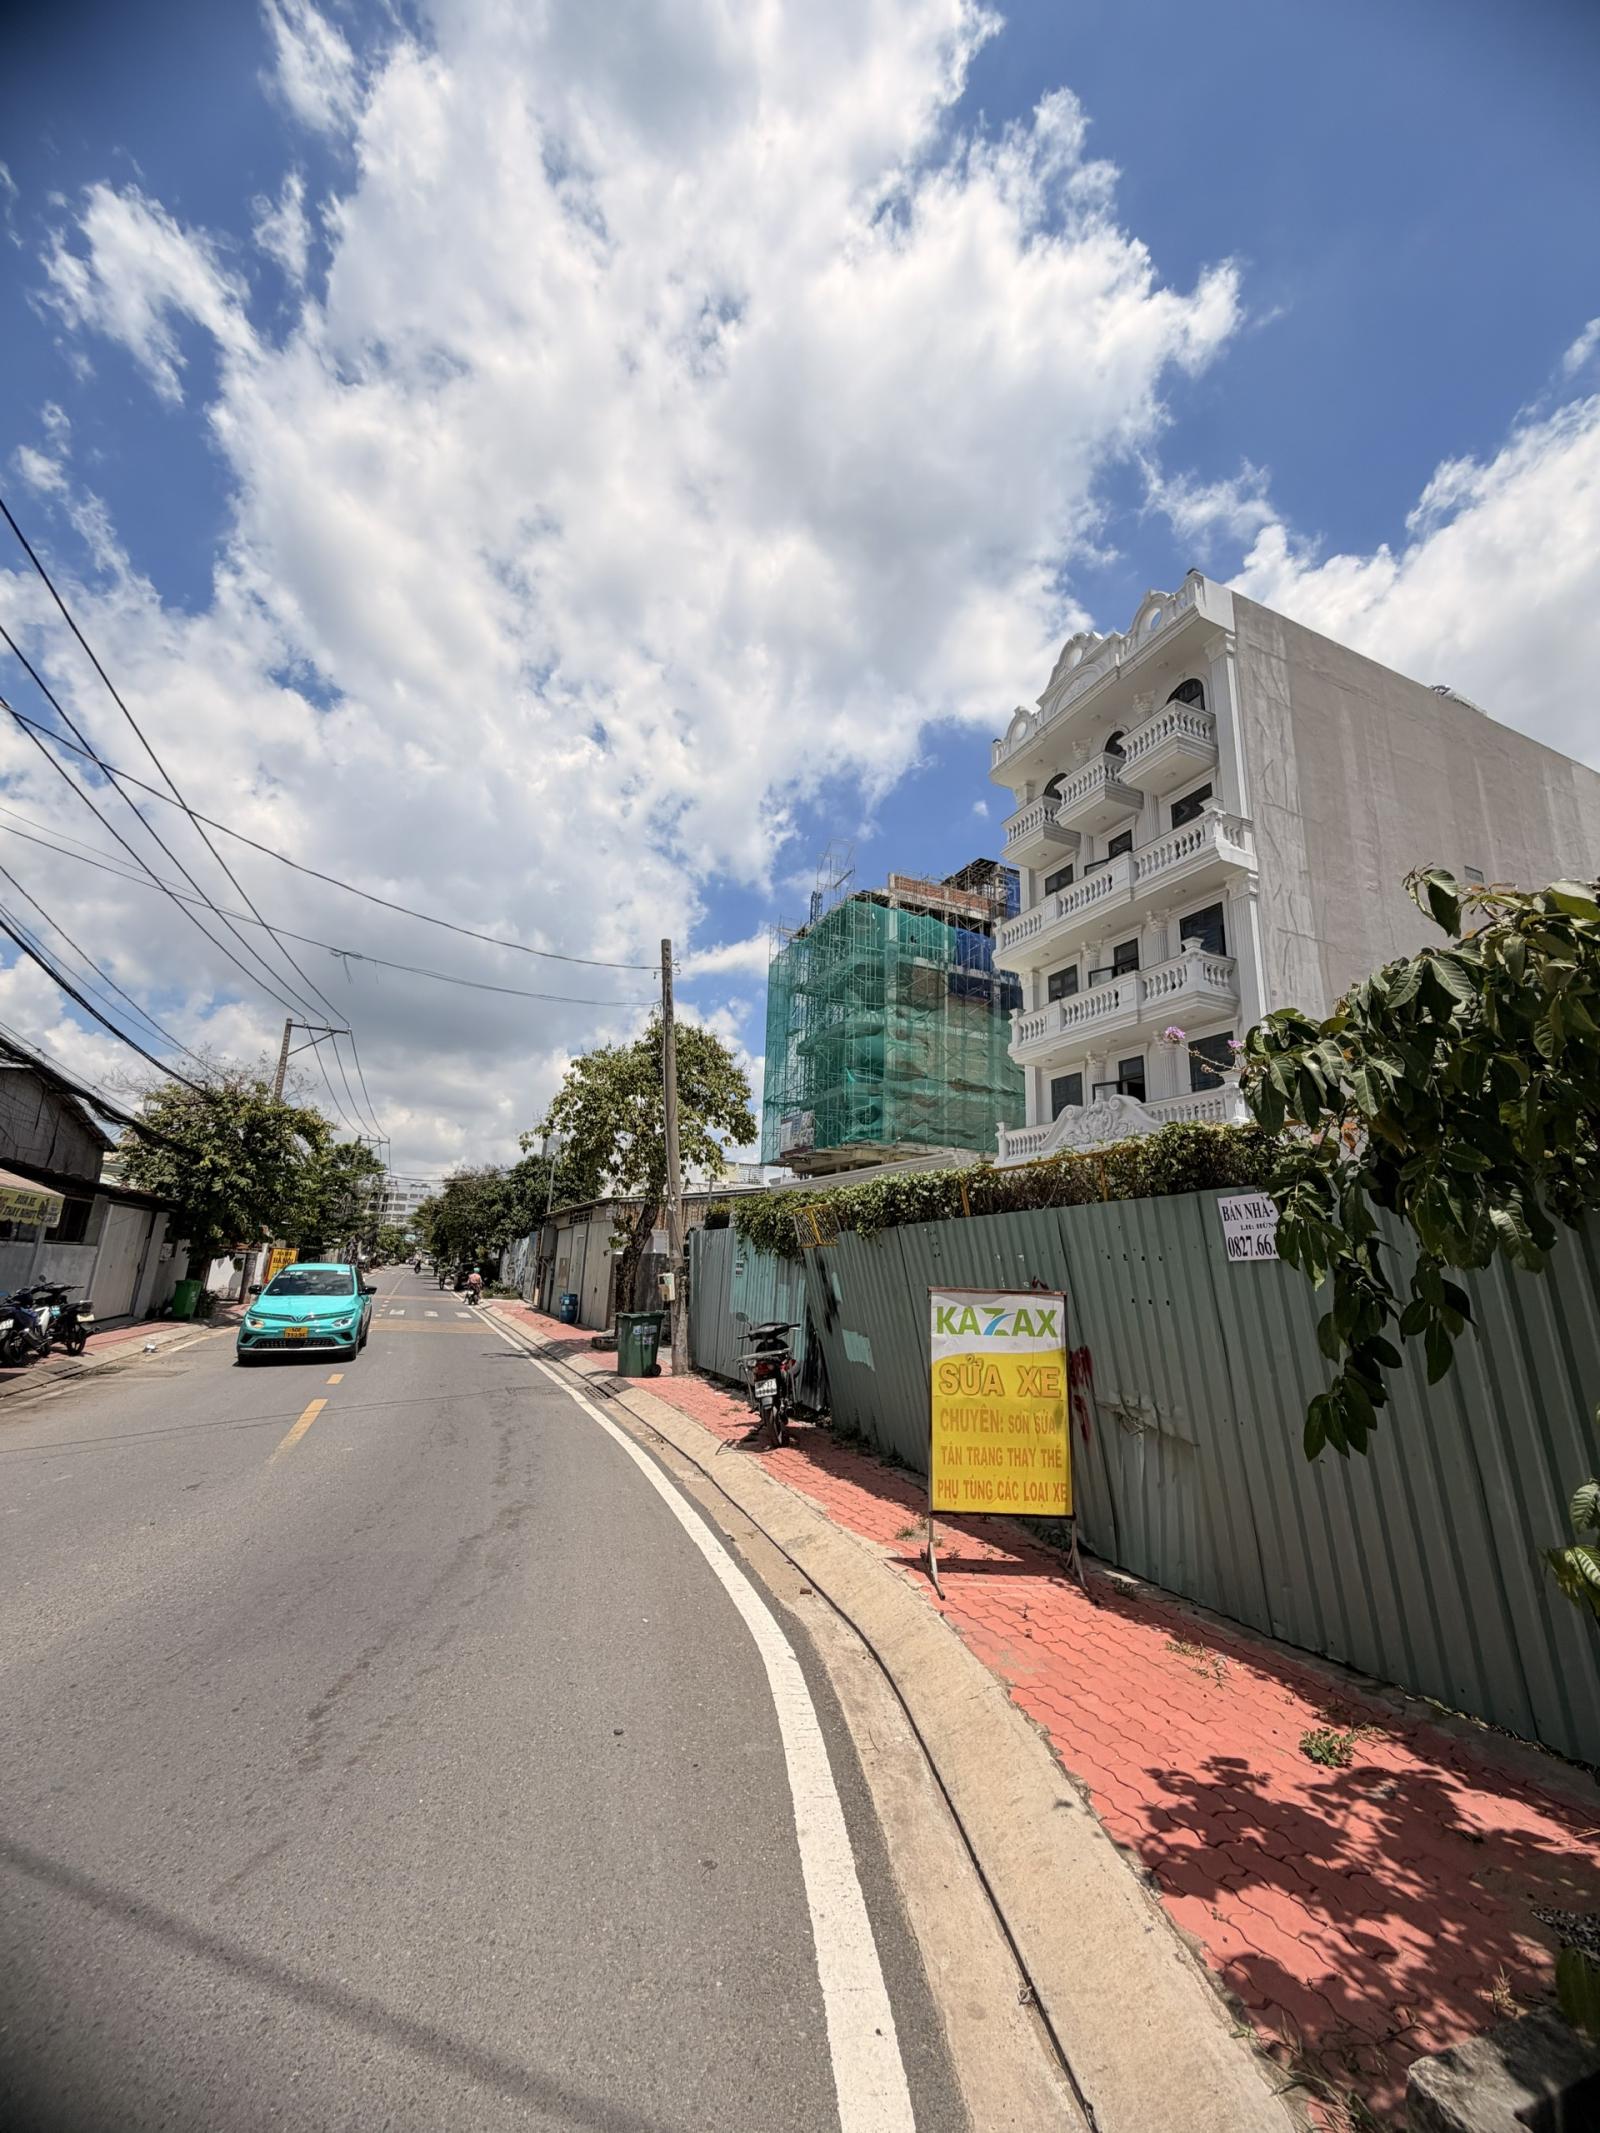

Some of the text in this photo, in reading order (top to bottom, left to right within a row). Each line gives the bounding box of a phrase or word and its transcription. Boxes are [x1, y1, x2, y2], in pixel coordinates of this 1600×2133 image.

[1222, 1200, 1243, 1221] BÁN
[1228, 1233, 1277, 1258] 0827.66.
[935, 1305, 1058, 1338] KAZAX
[938, 1353, 1062, 1398] SỬA XE
[940, 1403, 1004, 1433] CHUYÊN:
[967, 1447, 1003, 1466] TRANG
[1007, 1448, 1036, 1468] THAY
[937, 1479, 959, 1505] PHỤ
[997, 1475, 1019, 1501] CÁC
[1053, 1482, 1068, 1503] XE
